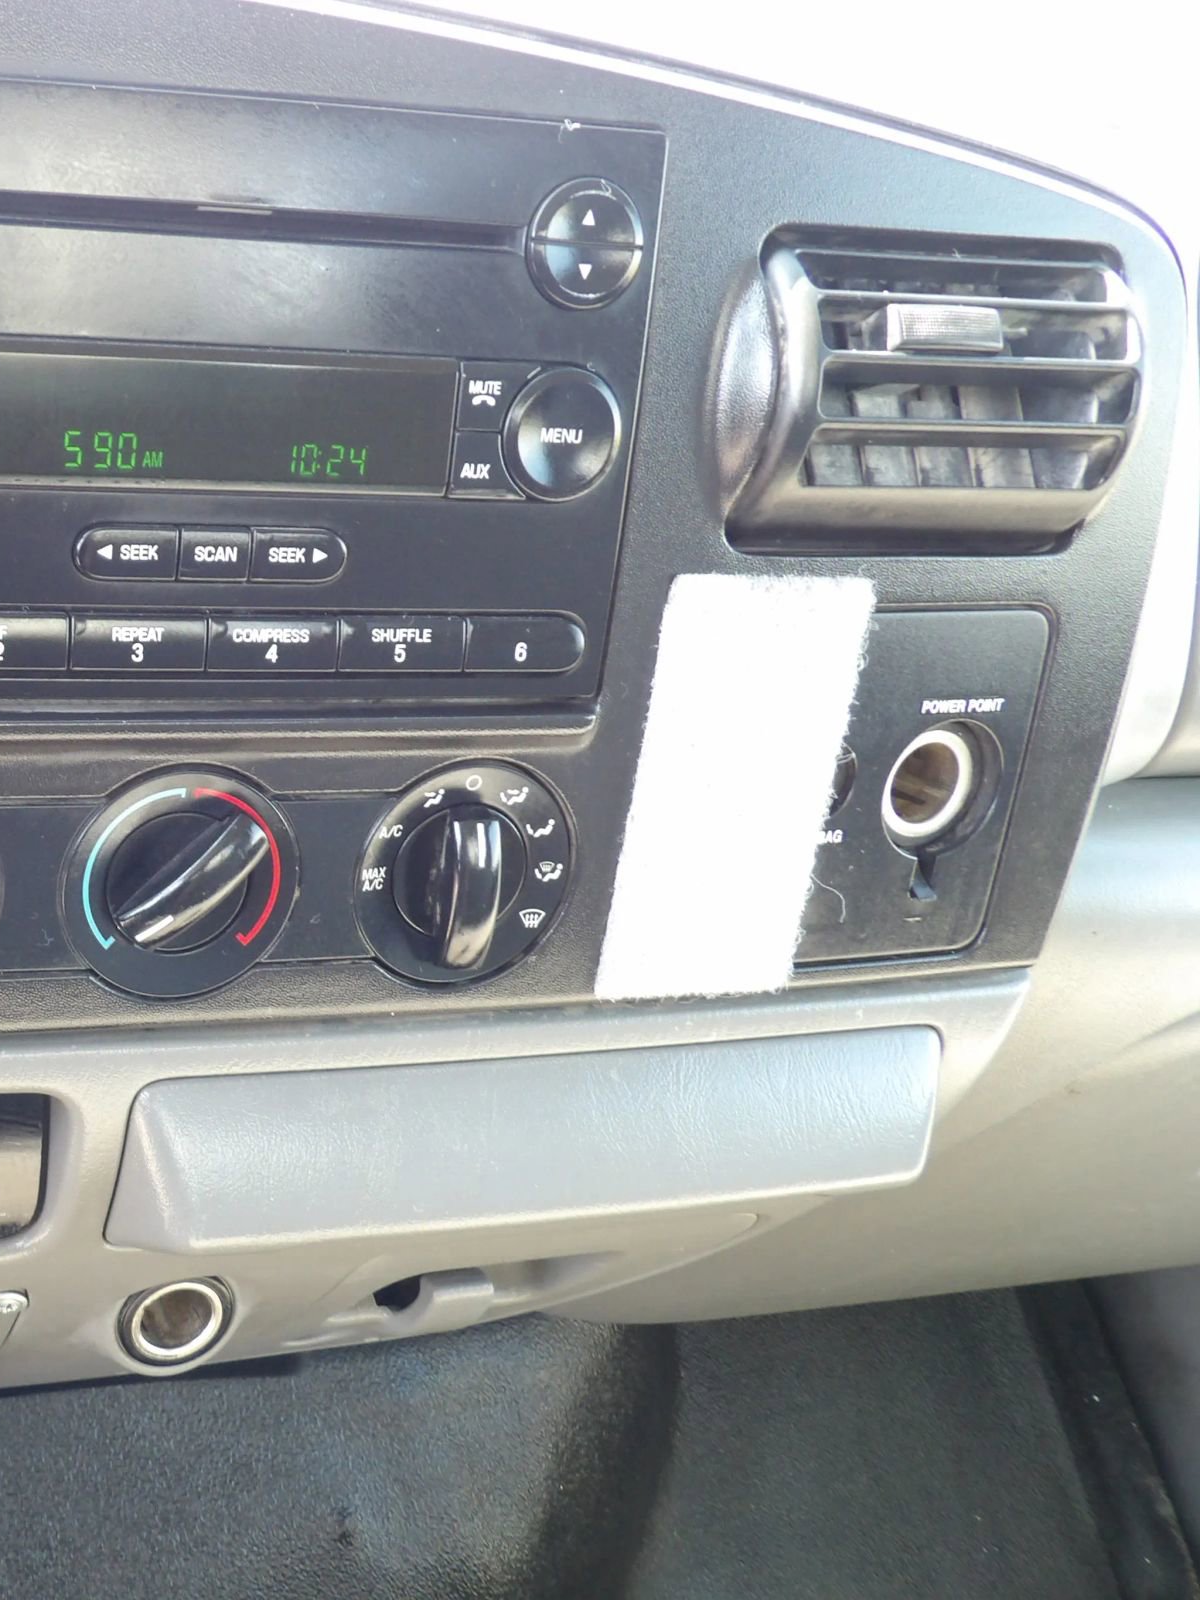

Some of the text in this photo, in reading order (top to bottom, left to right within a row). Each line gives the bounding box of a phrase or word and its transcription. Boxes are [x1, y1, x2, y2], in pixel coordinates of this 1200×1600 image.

[468, 380, 502, 395] MUTE
[540, 428, 583, 444] MENU
[142, 450, 163, 468] AM
[291, 444, 367, 476] 10:24
[460, 464, 490, 479] AUX
[119, 544, 159, 560] SEEK
[194, 546, 237, 562] SCAN
[268, 547, 306, 563] SEEK
[111, 626, 165, 642] REPEAT
[232, 629, 310, 643] COMPRESS
[371, 629, 432, 643] SHUFFLE
[131, 643, 144, 662] 3
[265, 644, 278, 663] 4
[394, 644, 406, 663] 5
[514, 642, 527, 662] 6
[921, 698, 1006, 714] POWER POINT
[378, 824, 403, 839] A/C
[362, 866, 387, 880] MAX
[362, 878, 384, 892] A/C
